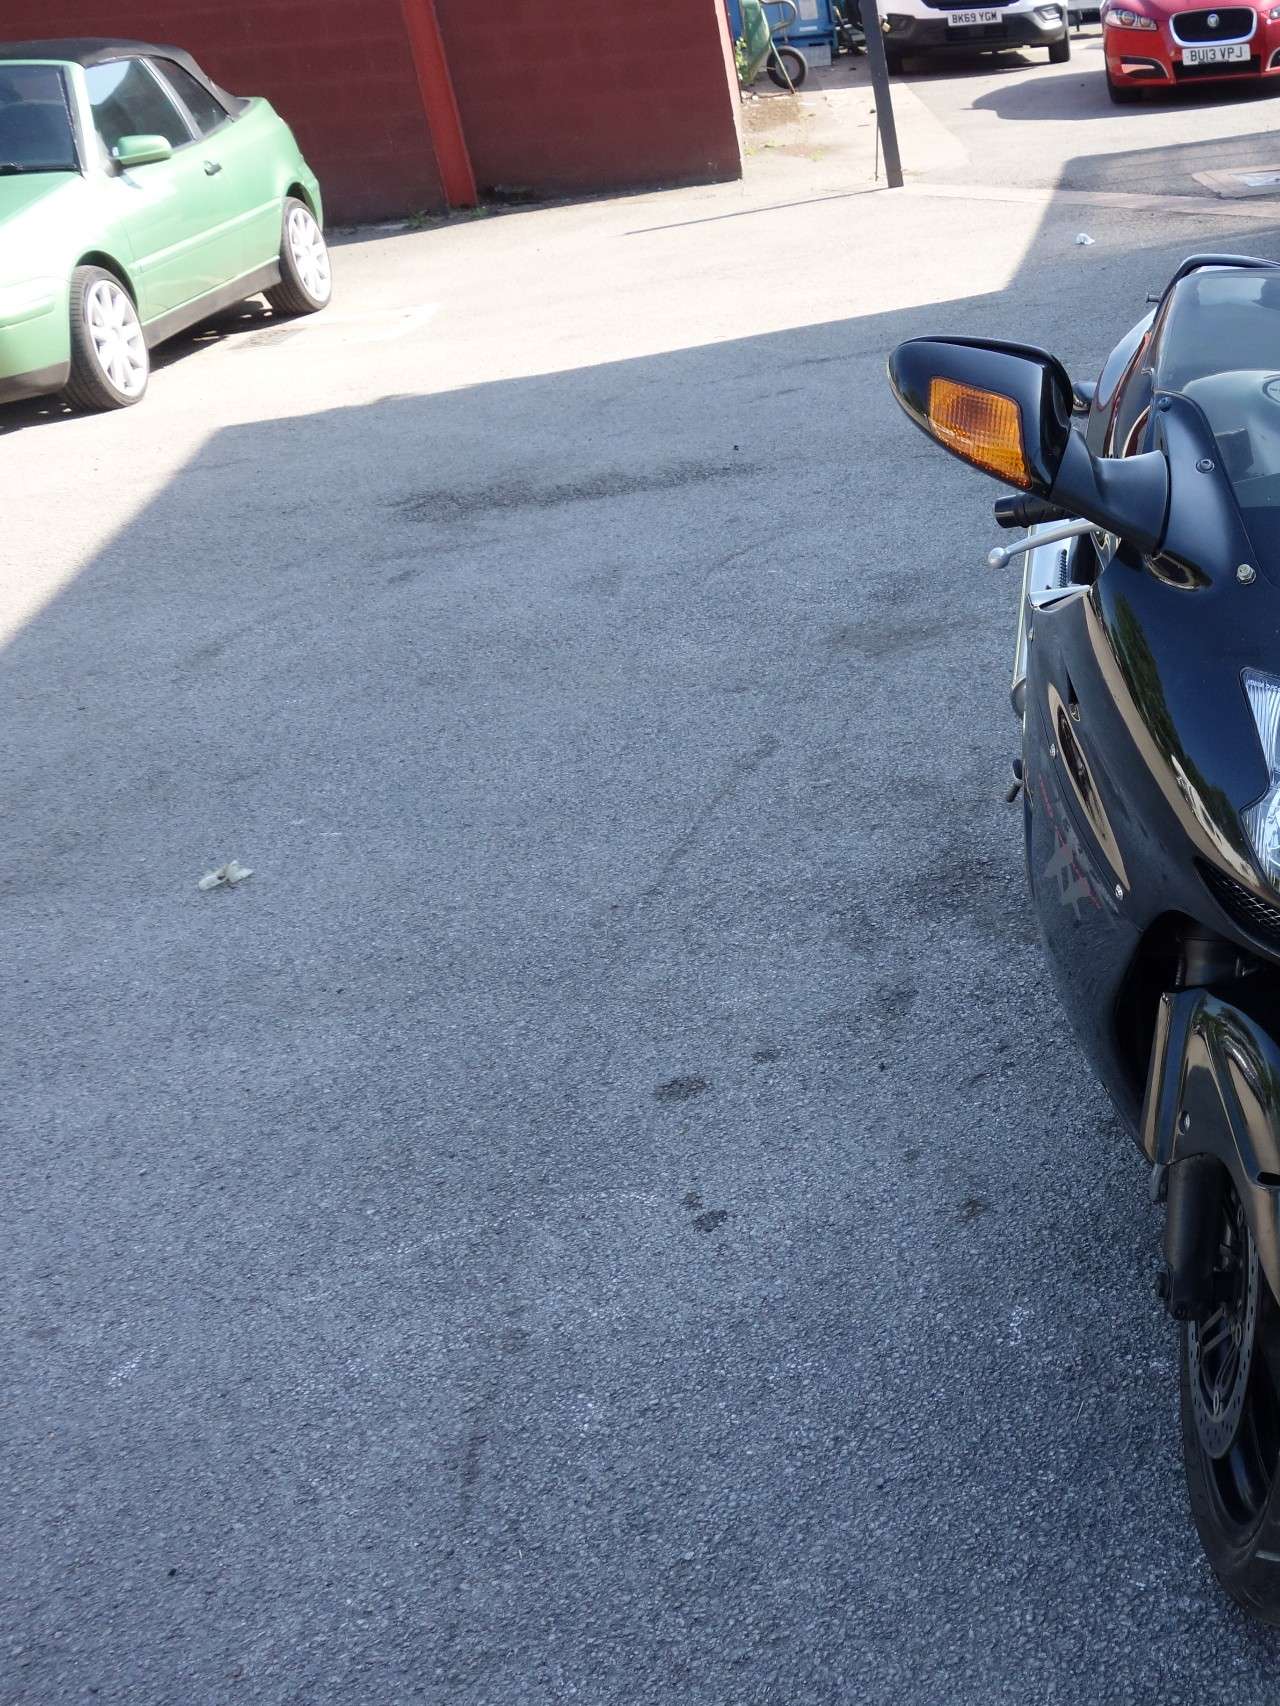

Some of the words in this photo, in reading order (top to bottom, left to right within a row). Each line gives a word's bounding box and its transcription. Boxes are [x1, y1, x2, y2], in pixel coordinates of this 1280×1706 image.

[952, 13, 976, 24] BK69
[1190, 48, 1216, 62] BU13
[1219, 46, 1243, 59] VPJ
